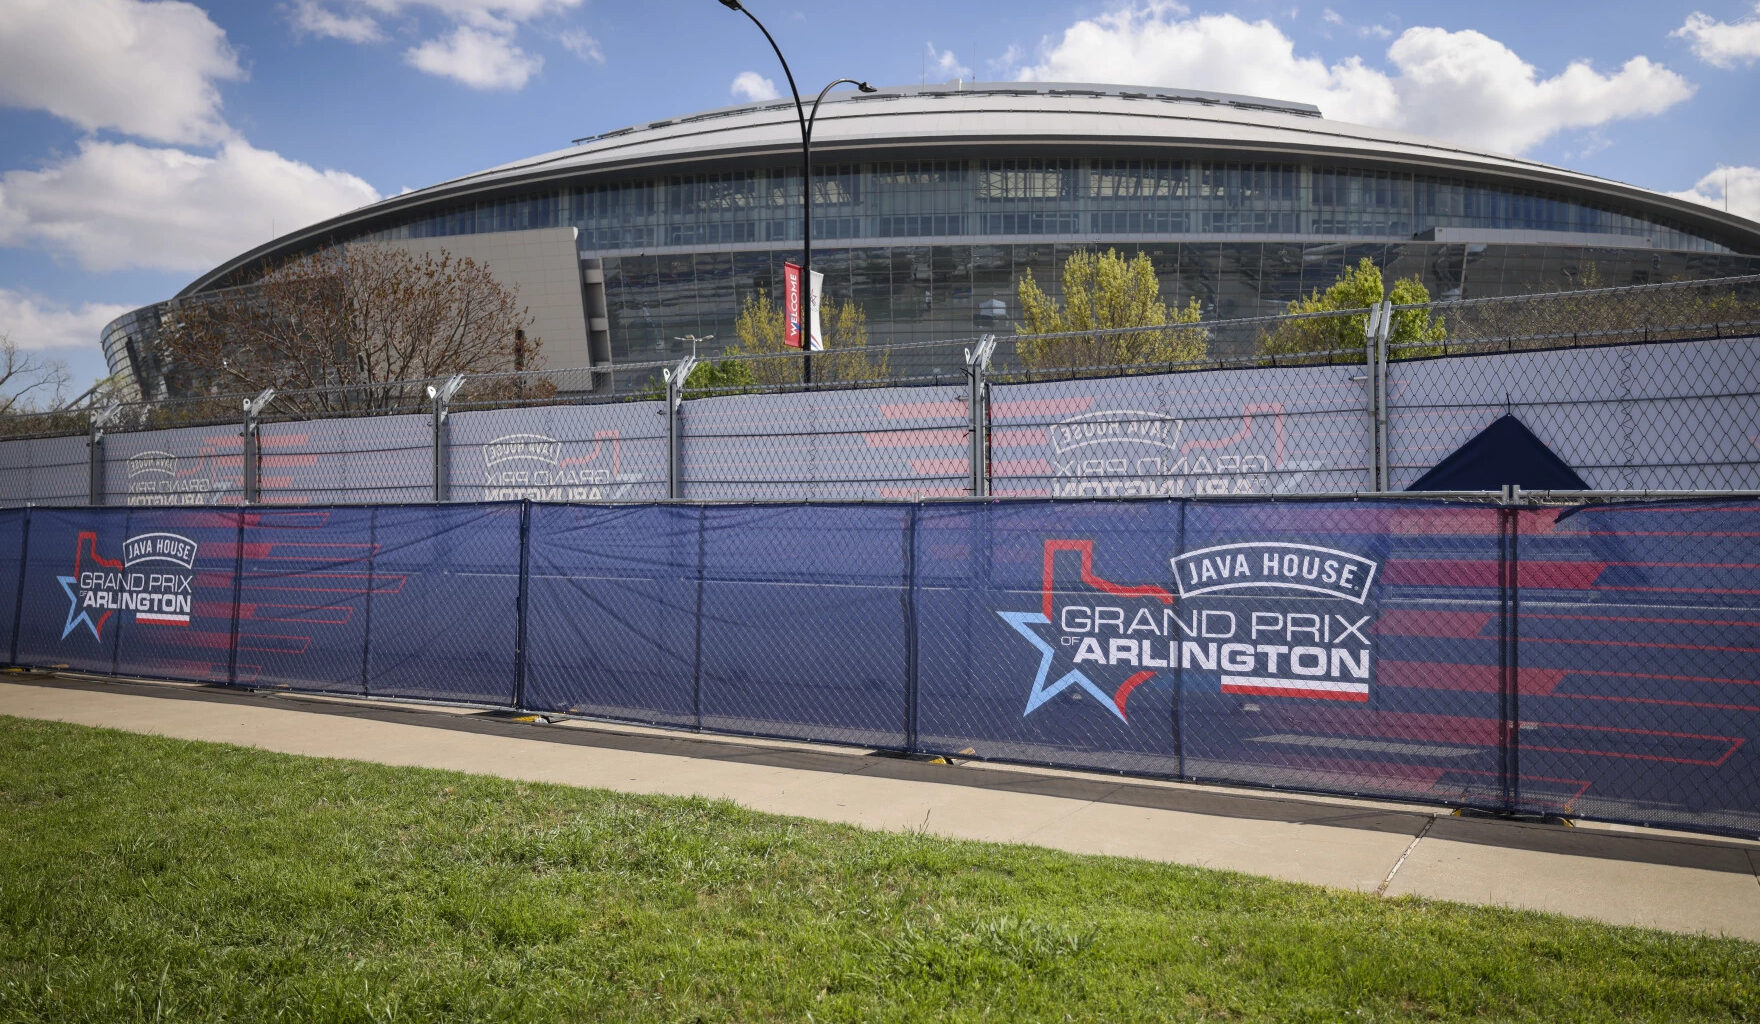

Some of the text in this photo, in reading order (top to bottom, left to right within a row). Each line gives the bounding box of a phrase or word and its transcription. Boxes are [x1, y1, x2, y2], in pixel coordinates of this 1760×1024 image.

[790, 274, 798, 336] WELCOME
[128, 538, 191, 559] JAVA HOUSE
[80, 572, 193, 593] GRAND PRIX
[1189, 552, 1358, 589] JAVA HOUSE
[83, 591, 191, 613] ARLINGTON
[1061, 605, 1371, 645] GRAND PRIX
[1060, 636, 1080, 646] OF
[1072, 636, 1370, 680] ARLINGTON
